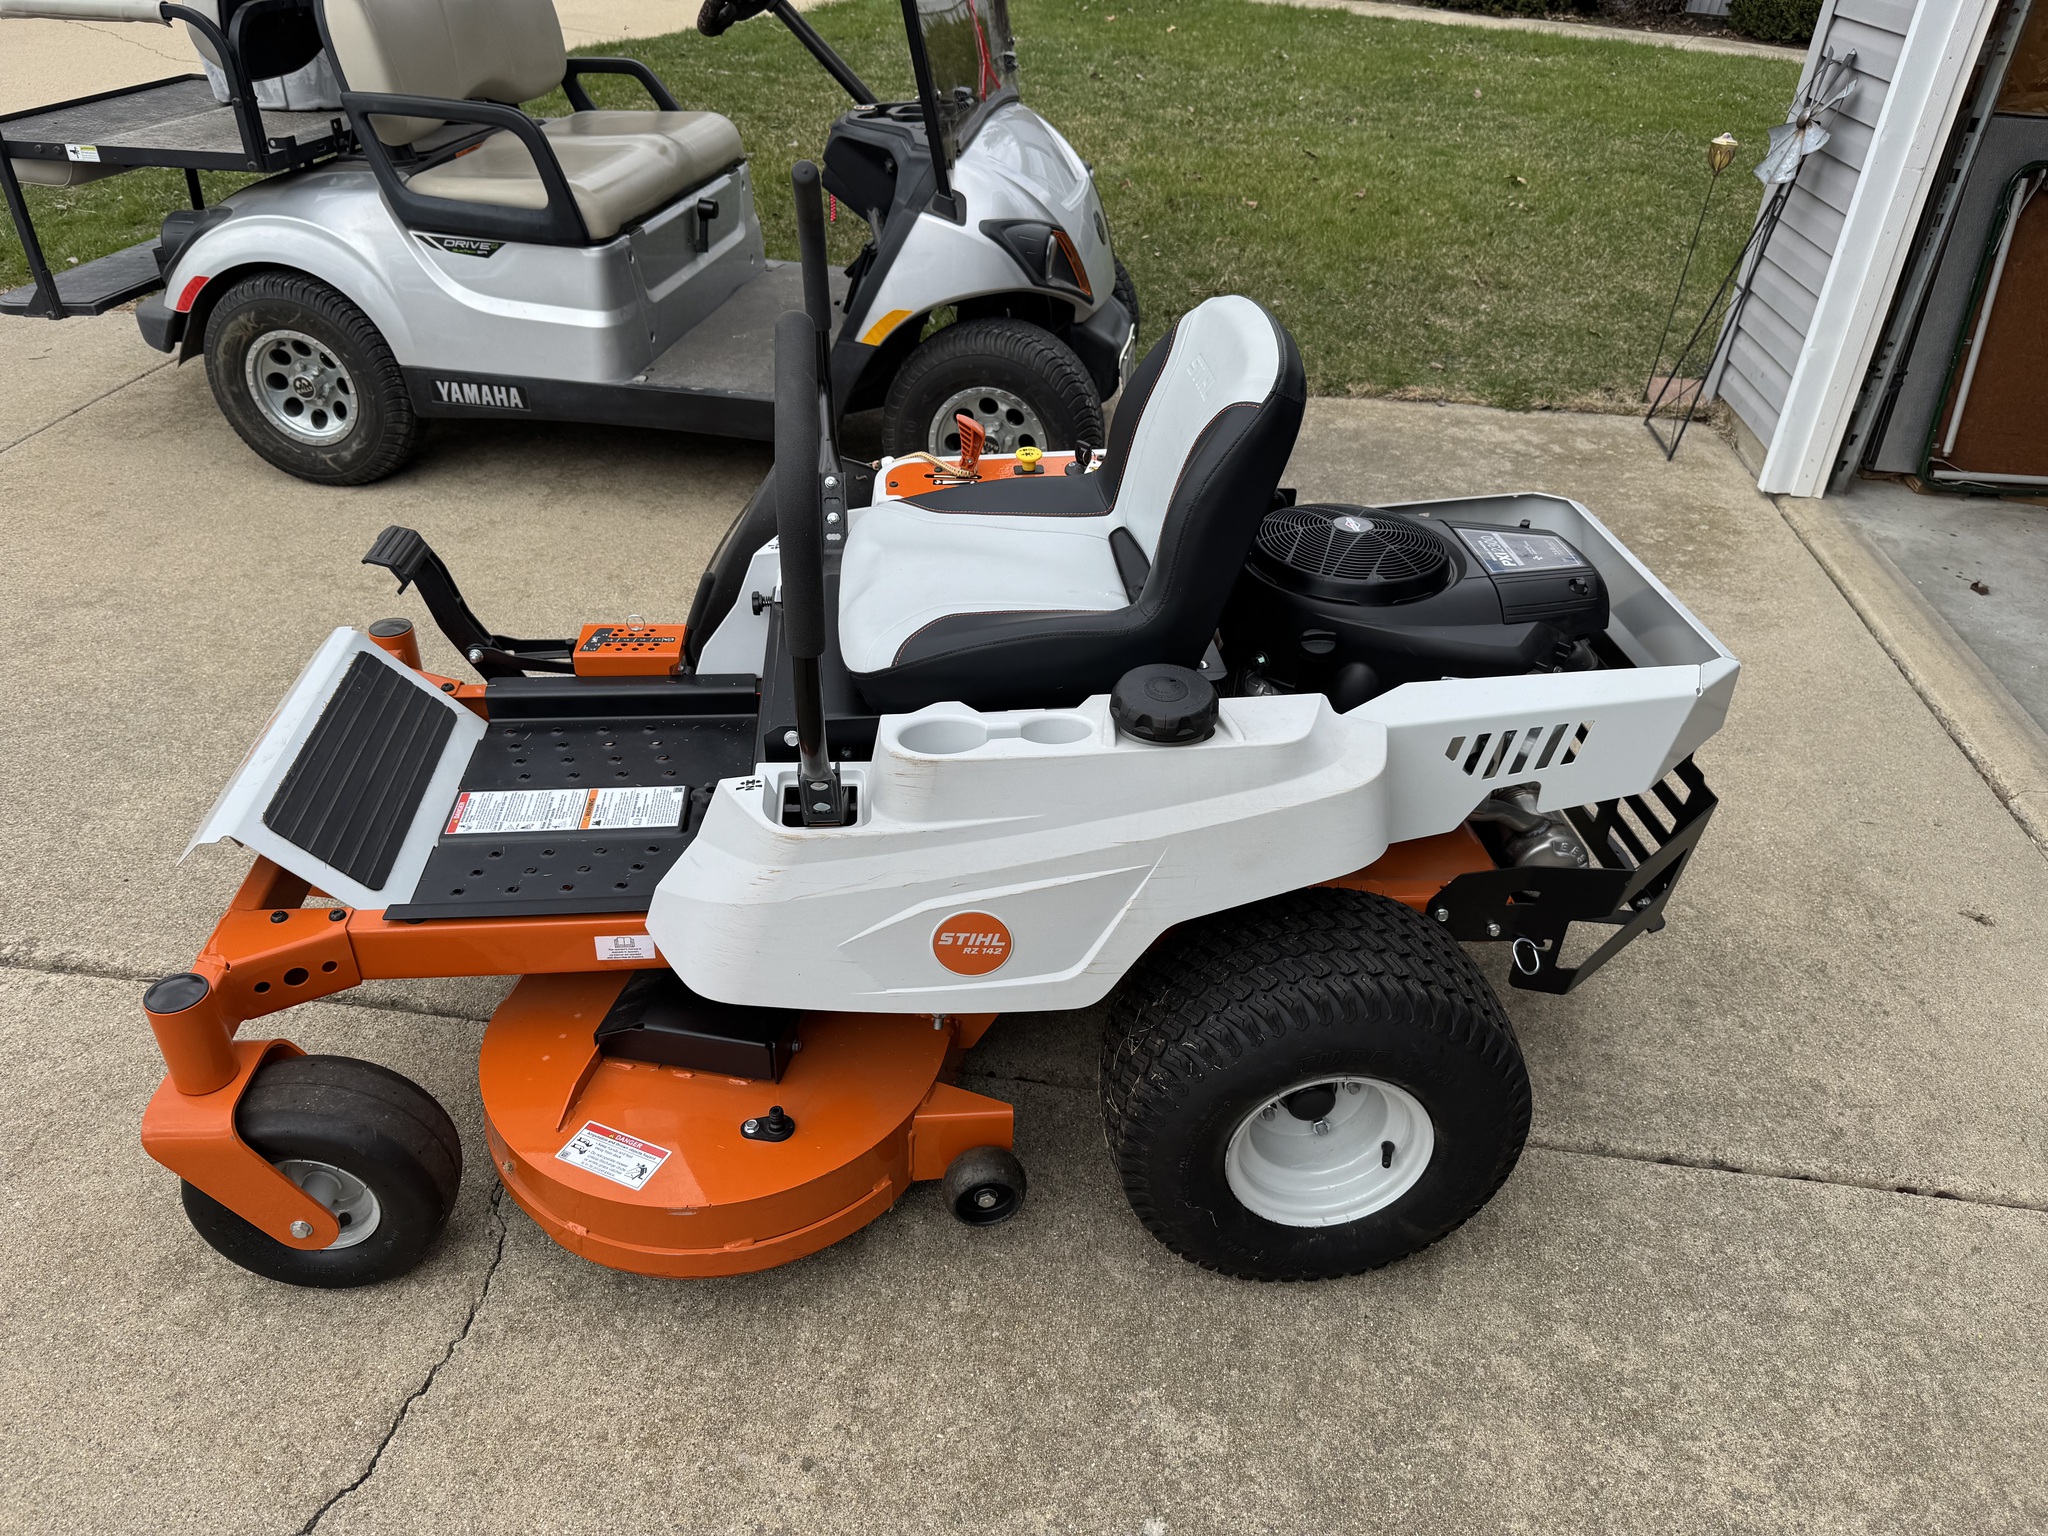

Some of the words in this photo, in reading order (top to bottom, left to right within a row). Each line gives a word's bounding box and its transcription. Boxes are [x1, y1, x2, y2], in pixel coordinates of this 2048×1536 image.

[435, 380, 524, 408] YAMAHA
[453, 802, 465, 818] DANGER
[584, 797, 596, 816] WARNING
[938, 932, 1006, 946] STIHL
[962, 947, 980, 955] RZ
[982, 947, 1003, 955] 142
[615, 1135, 643, 1148] DANGER
